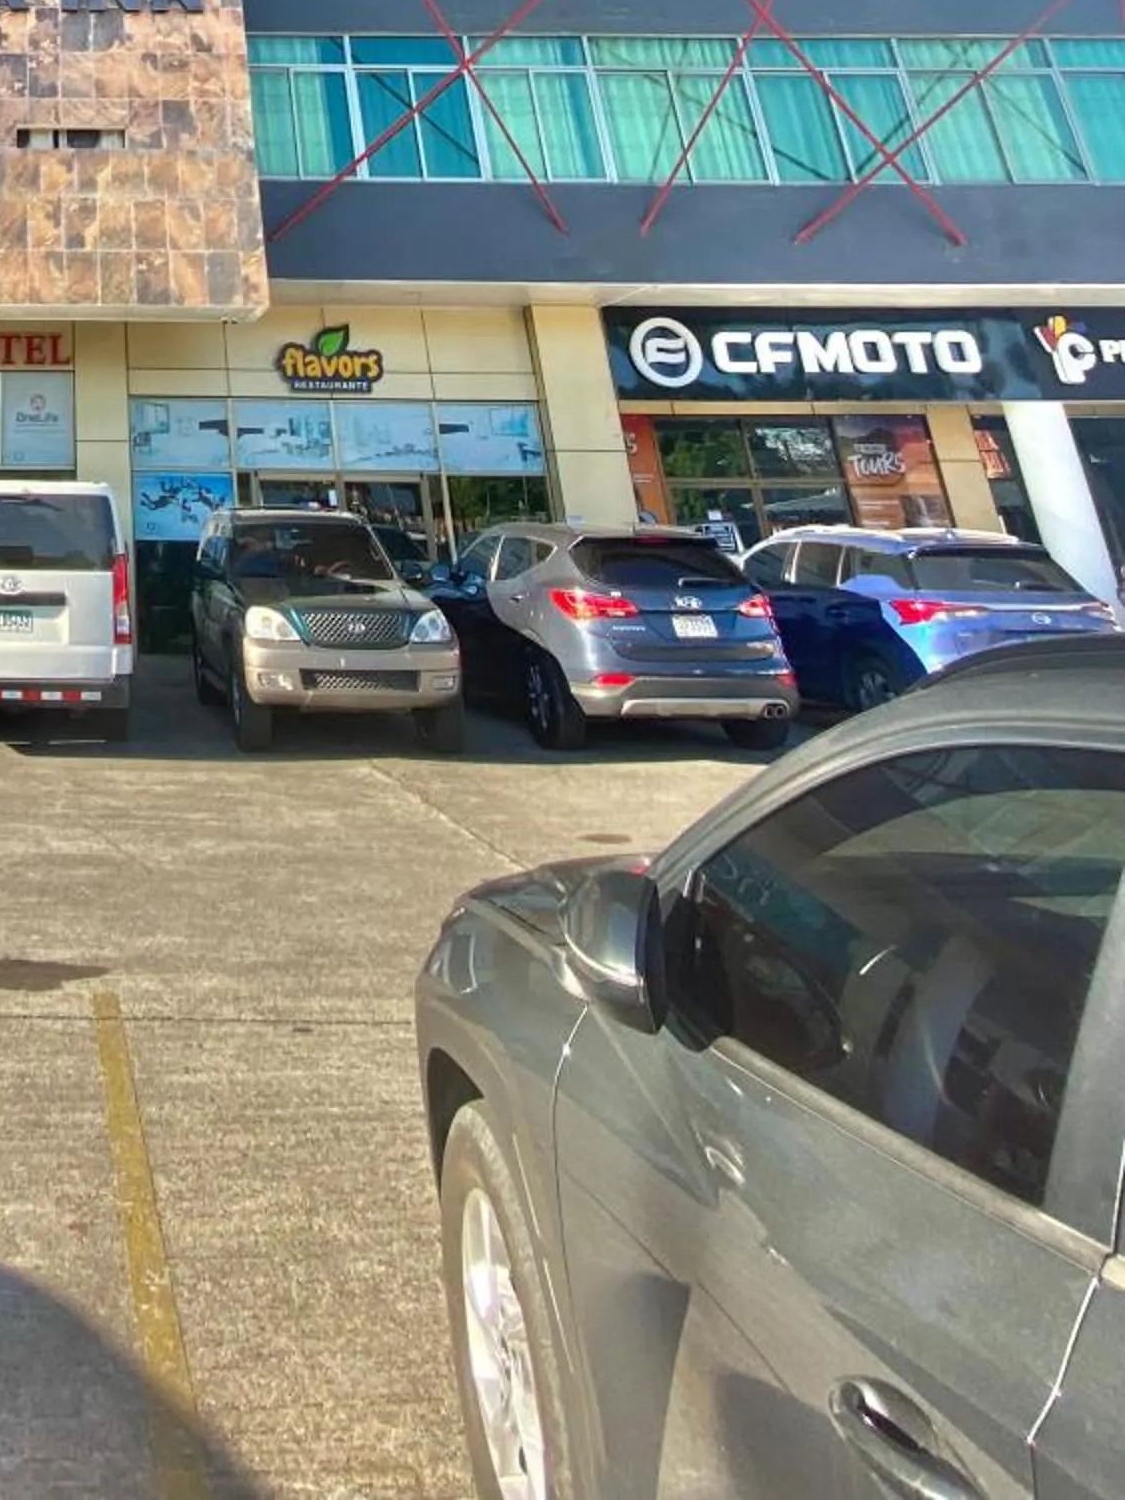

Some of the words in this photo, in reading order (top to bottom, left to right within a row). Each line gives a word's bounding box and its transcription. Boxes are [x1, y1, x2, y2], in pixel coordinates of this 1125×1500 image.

[282, 346, 380, 379] flavors
[711, 329, 983, 374] CFMOTO
[293, 380, 369, 391] RESTAURANTE
